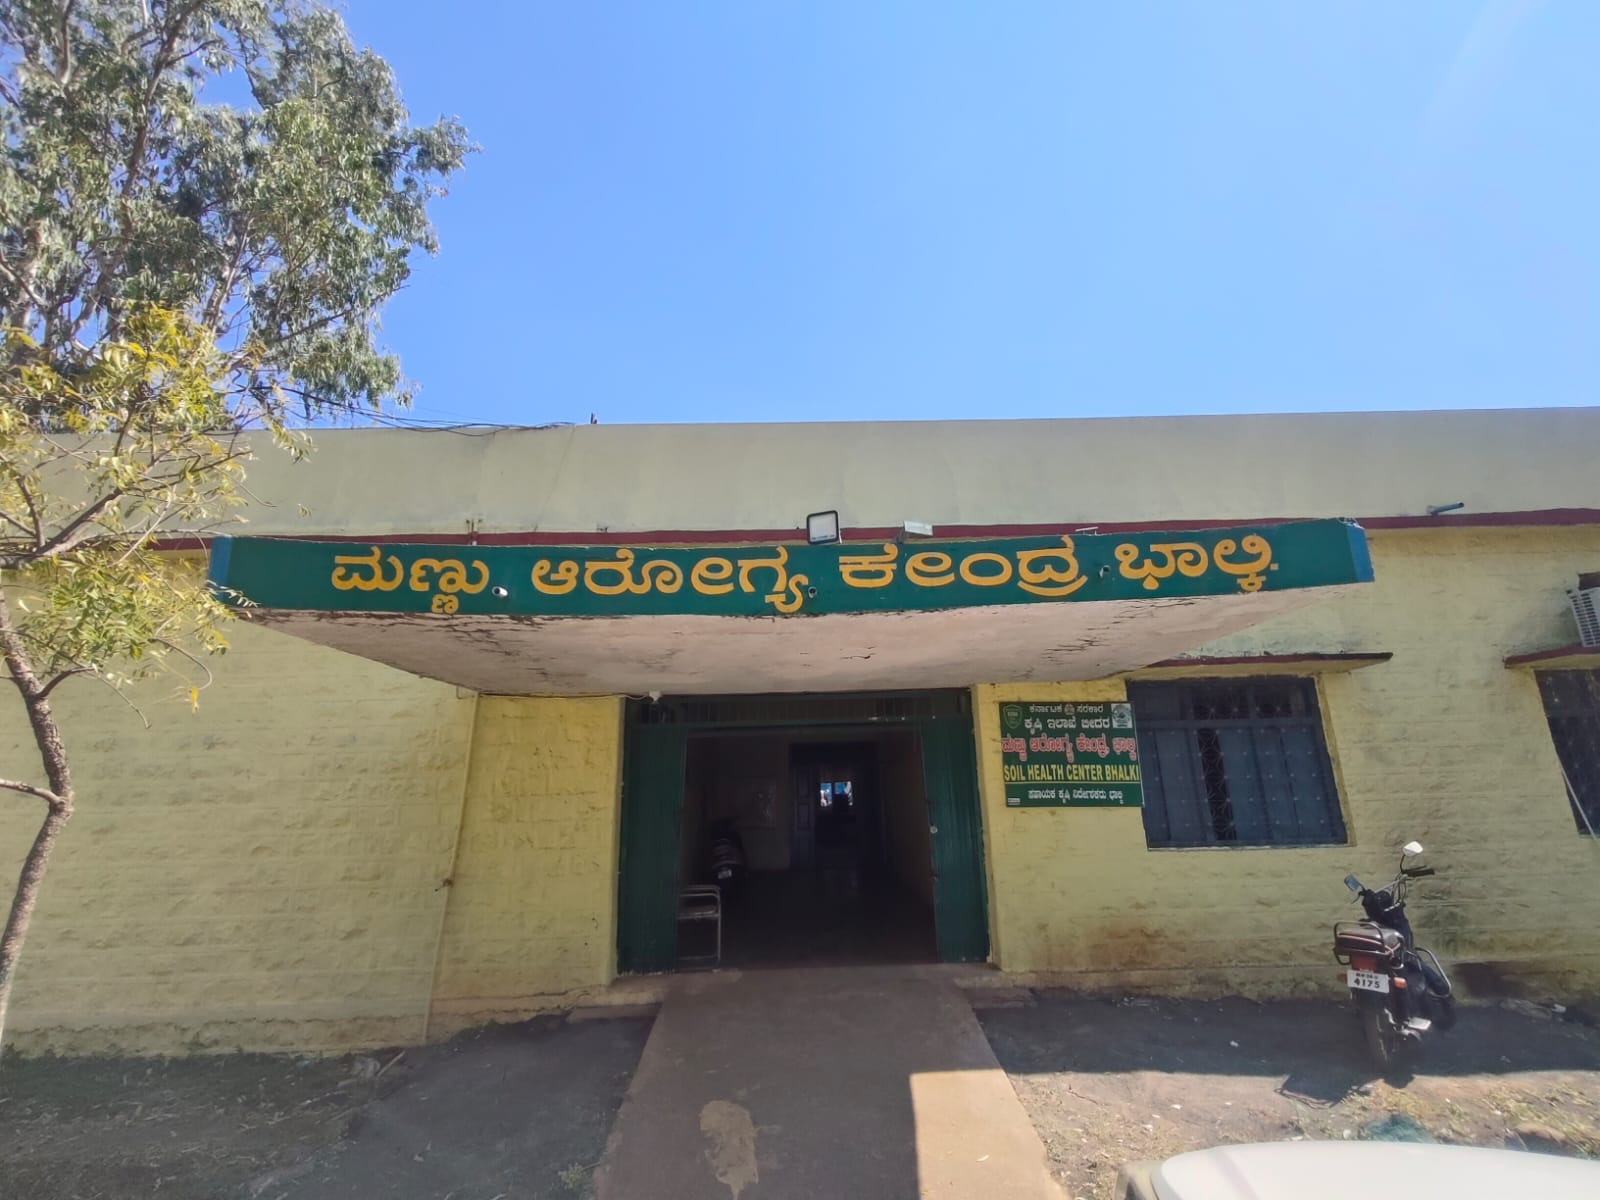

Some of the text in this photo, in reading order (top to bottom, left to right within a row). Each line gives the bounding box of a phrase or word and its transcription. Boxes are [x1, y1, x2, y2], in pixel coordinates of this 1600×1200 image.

[331, 546, 490, 614] ಮಣ್ಣು
[531, 546, 810, 614] ಆರೋಗ್ಯ
[838, 534, 1088, 597] ಕೇಂದ್ರ
[1004, 764, 1140, 781] SOIL HEALTH CENTER BHALKI
[1354, 978, 1380, 988] 4175
